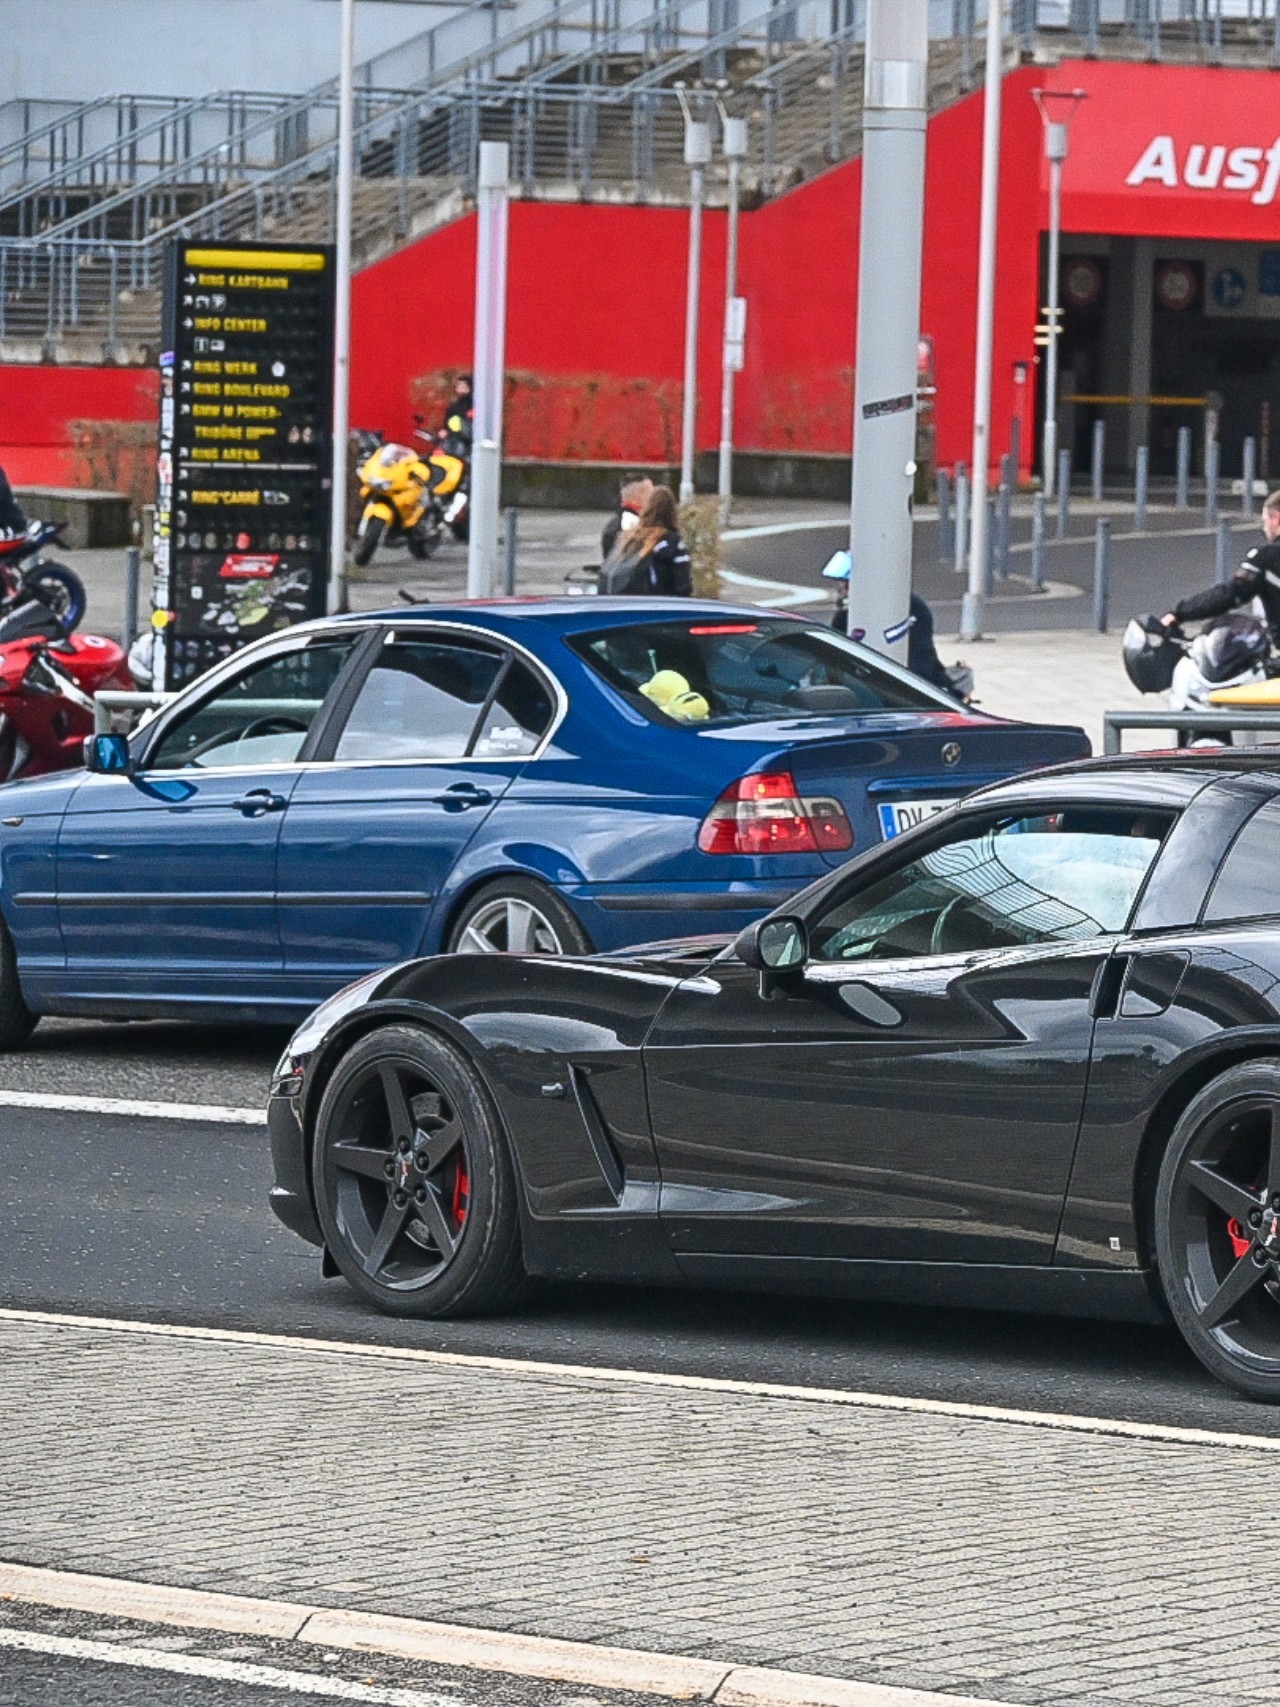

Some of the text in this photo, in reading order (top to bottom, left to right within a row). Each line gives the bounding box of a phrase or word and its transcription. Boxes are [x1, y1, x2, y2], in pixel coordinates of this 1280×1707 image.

[194, 317, 267, 332] INFO CENTER
[223, 382, 291, 398] BOULEVARD
[222, 448, 261, 462] ARENA
